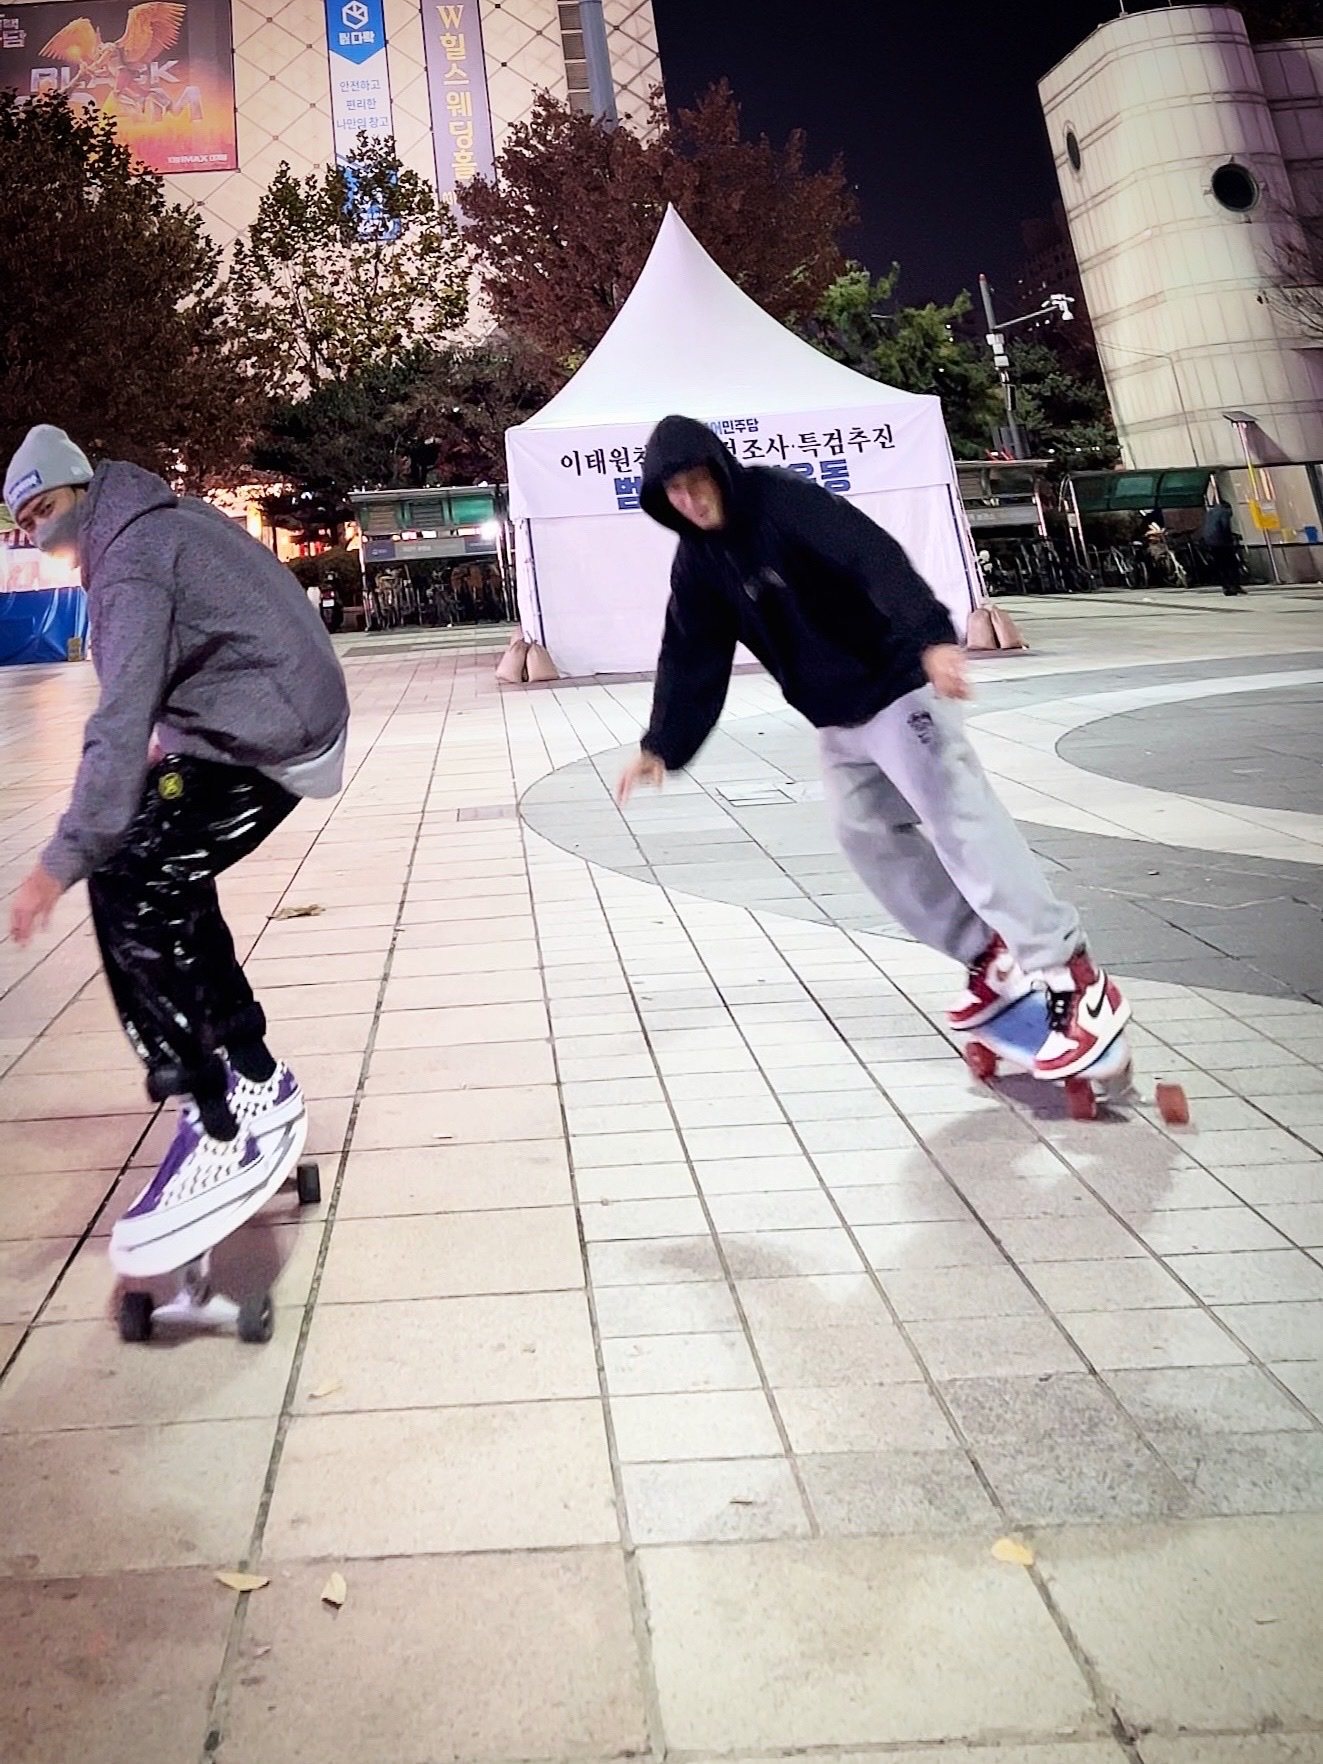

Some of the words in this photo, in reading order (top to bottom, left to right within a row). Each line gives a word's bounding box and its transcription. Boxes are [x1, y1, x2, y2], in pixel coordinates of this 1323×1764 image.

[339, 80, 381, 92] 안전하고
[346, 98, 376, 110] 편리한
[708, 418, 759, 435] 어민주당
[560, 444, 646, 476] 이태원
[723, 423, 896, 460] 조사·특검추진
